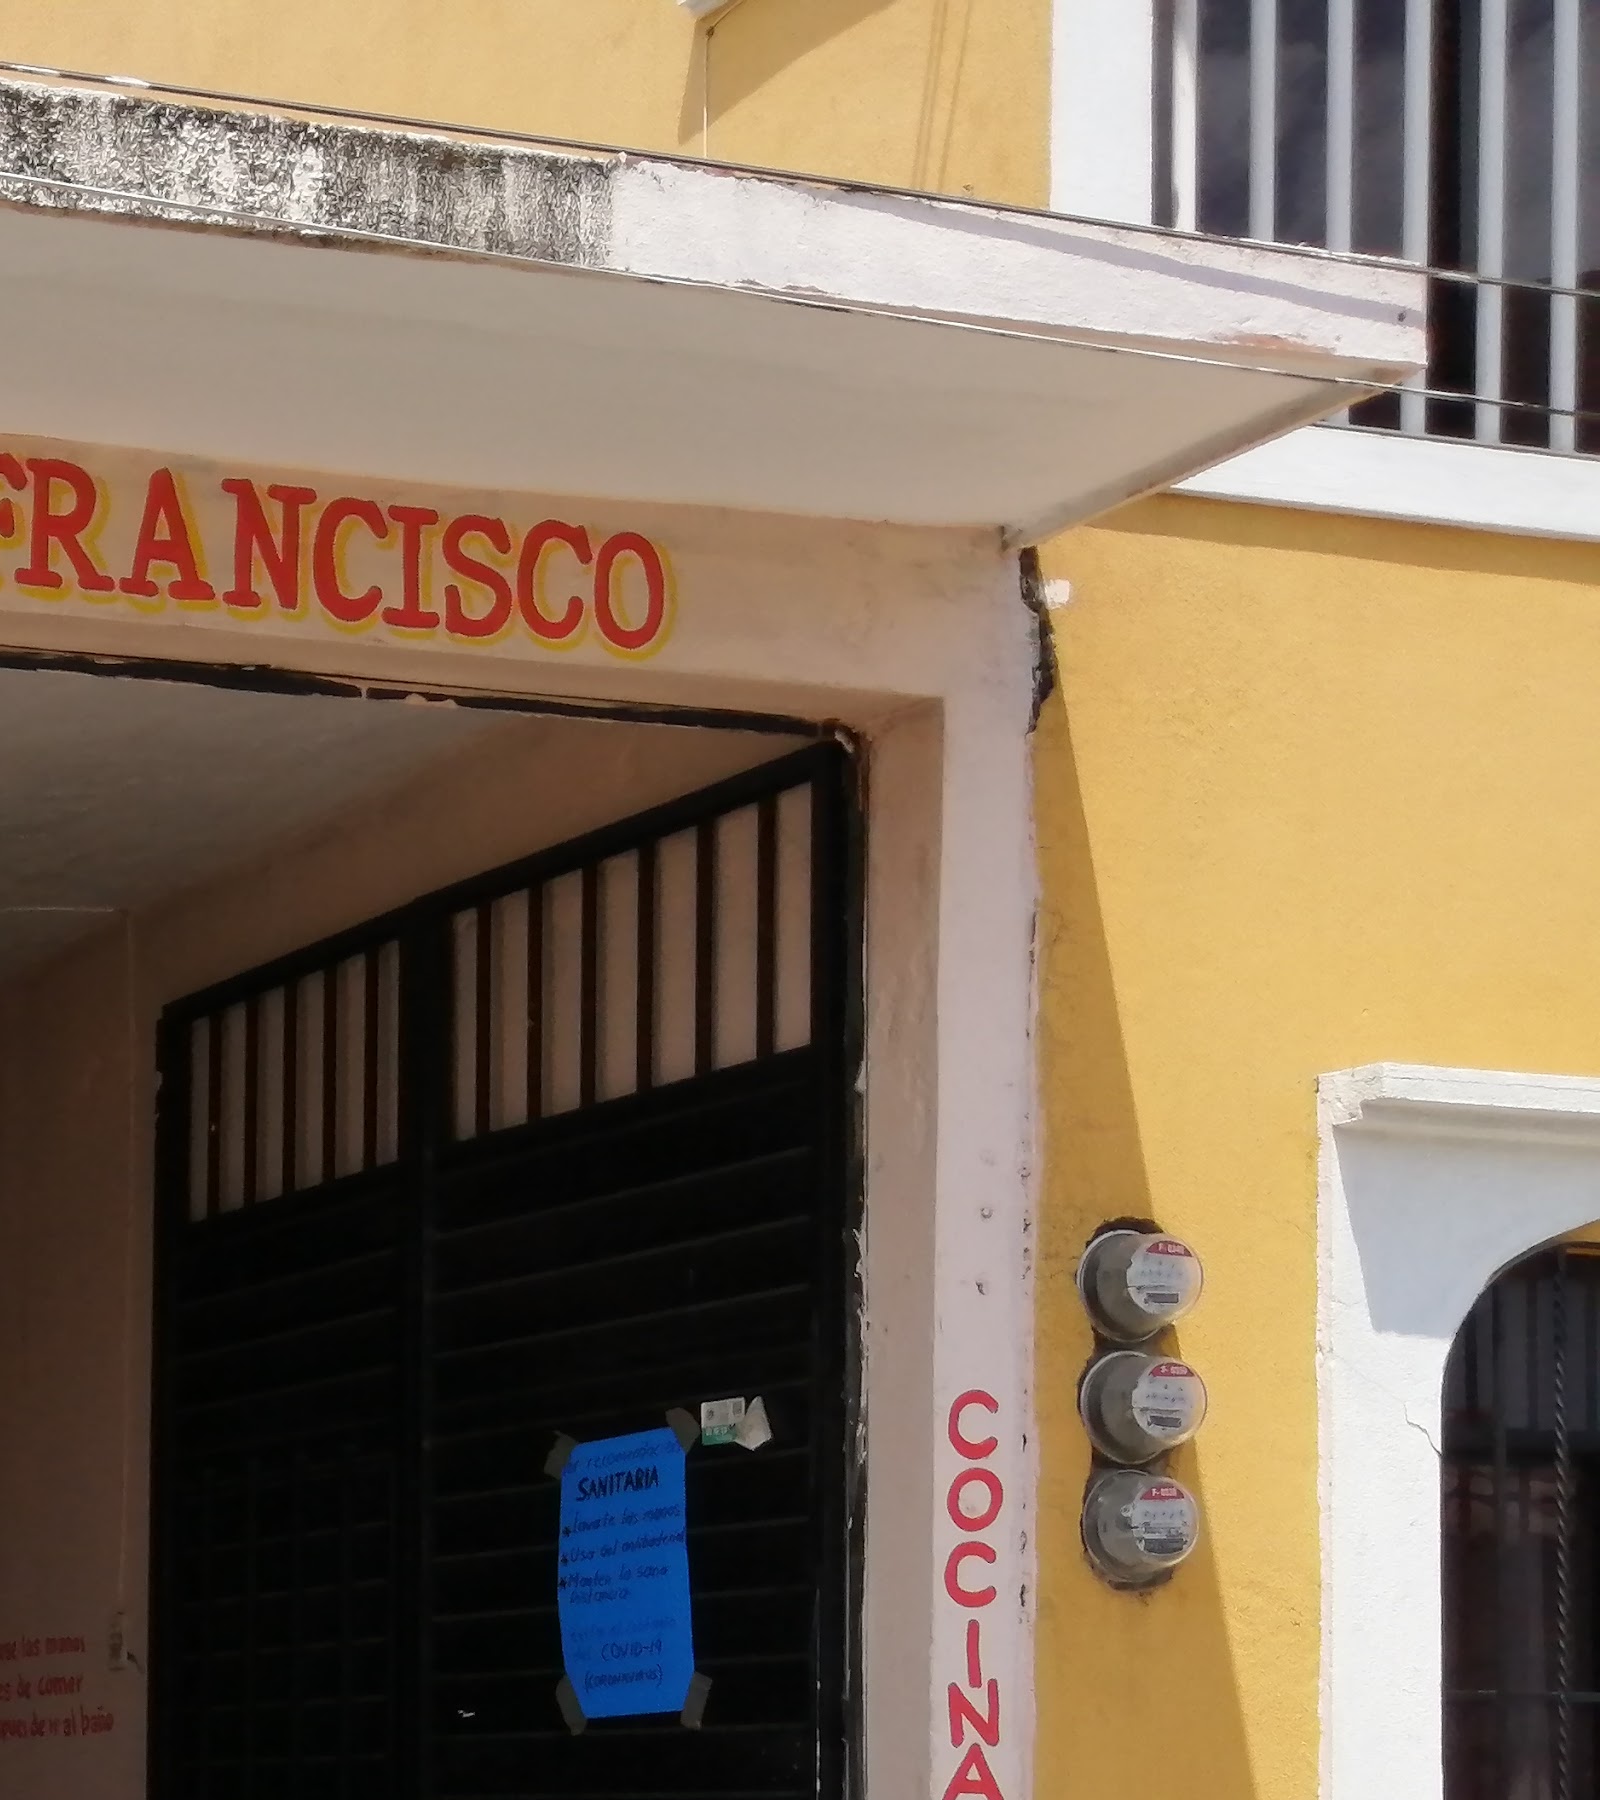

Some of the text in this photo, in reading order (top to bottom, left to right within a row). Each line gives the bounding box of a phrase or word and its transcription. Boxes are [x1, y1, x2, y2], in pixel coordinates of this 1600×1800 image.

[576, 1463, 660, 1502] SANITARIA
[17, 1672, 32, 1699] de
[63, 1706, 77, 1737] al
